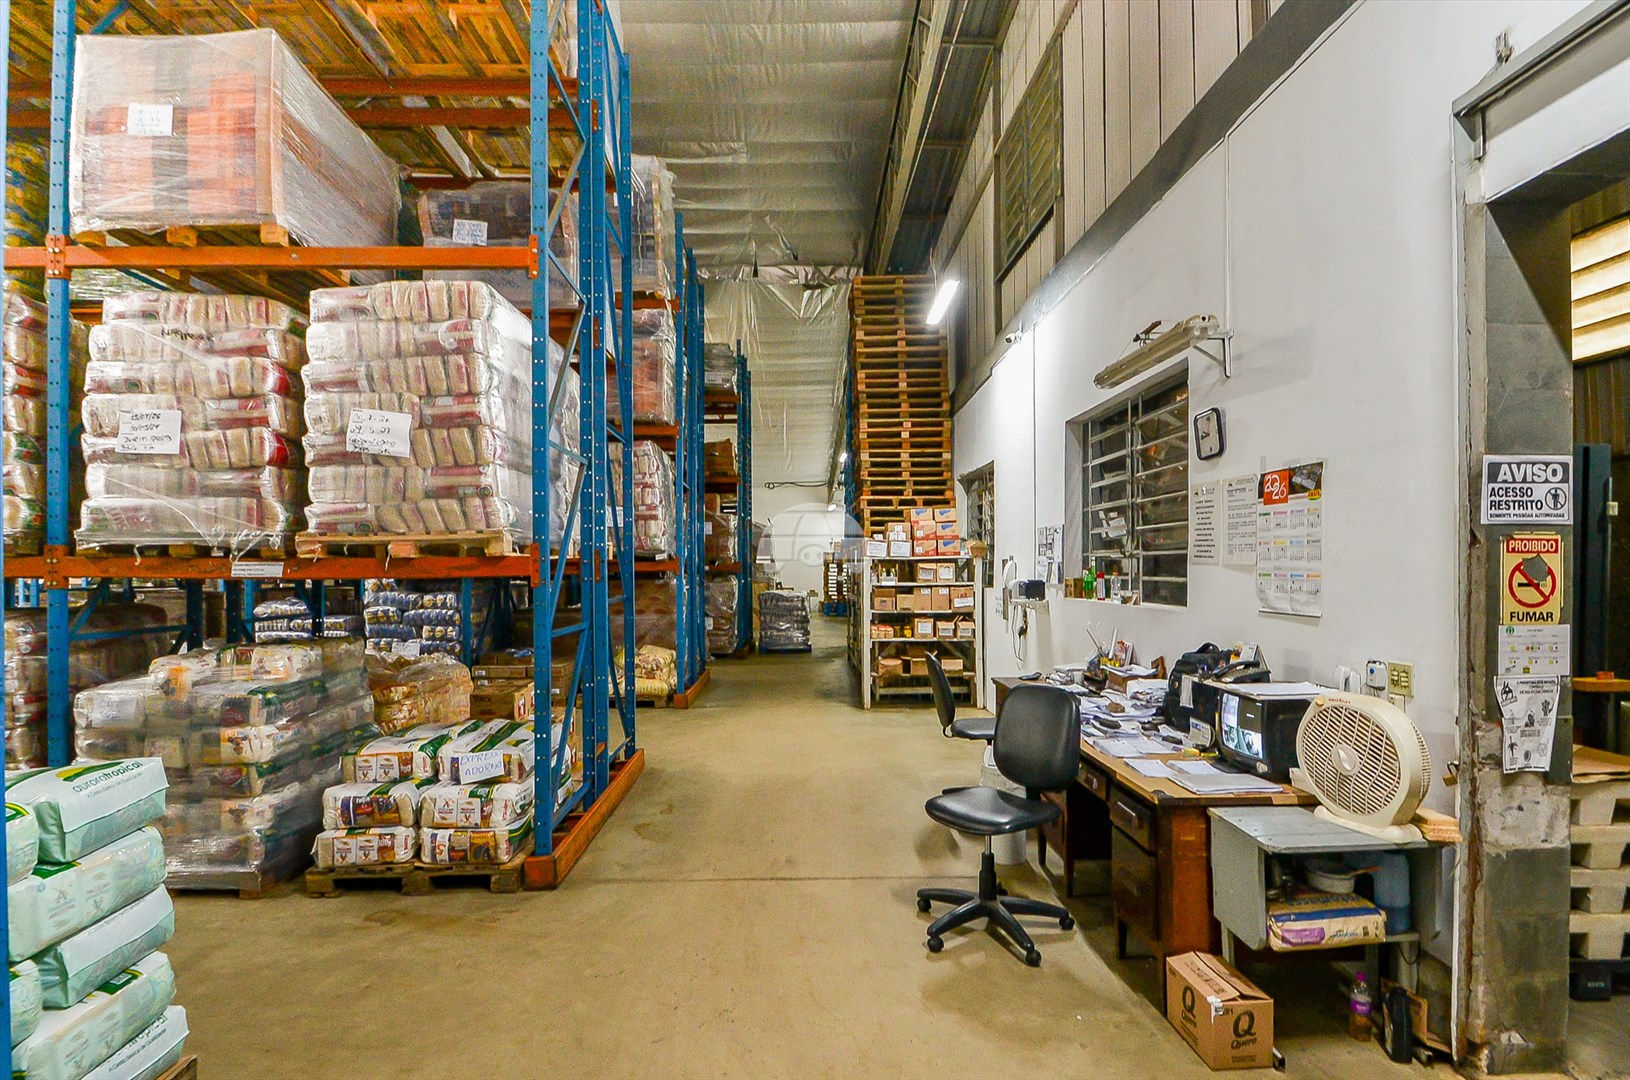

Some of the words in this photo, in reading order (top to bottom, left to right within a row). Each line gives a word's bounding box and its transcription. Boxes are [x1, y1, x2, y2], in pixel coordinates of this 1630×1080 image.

[1497, 463, 1563, 483] AVISO
[1489, 487, 1534, 498] ACESSO
[1489, 499, 1544, 511] RESTRITO
[1508, 540, 1557, 552] PROIBIDO
[1509, 611, 1554, 622] FUMAR
[72, 761, 144, 793] auroratropical
[1232, 1010, 1257, 1038] Q
